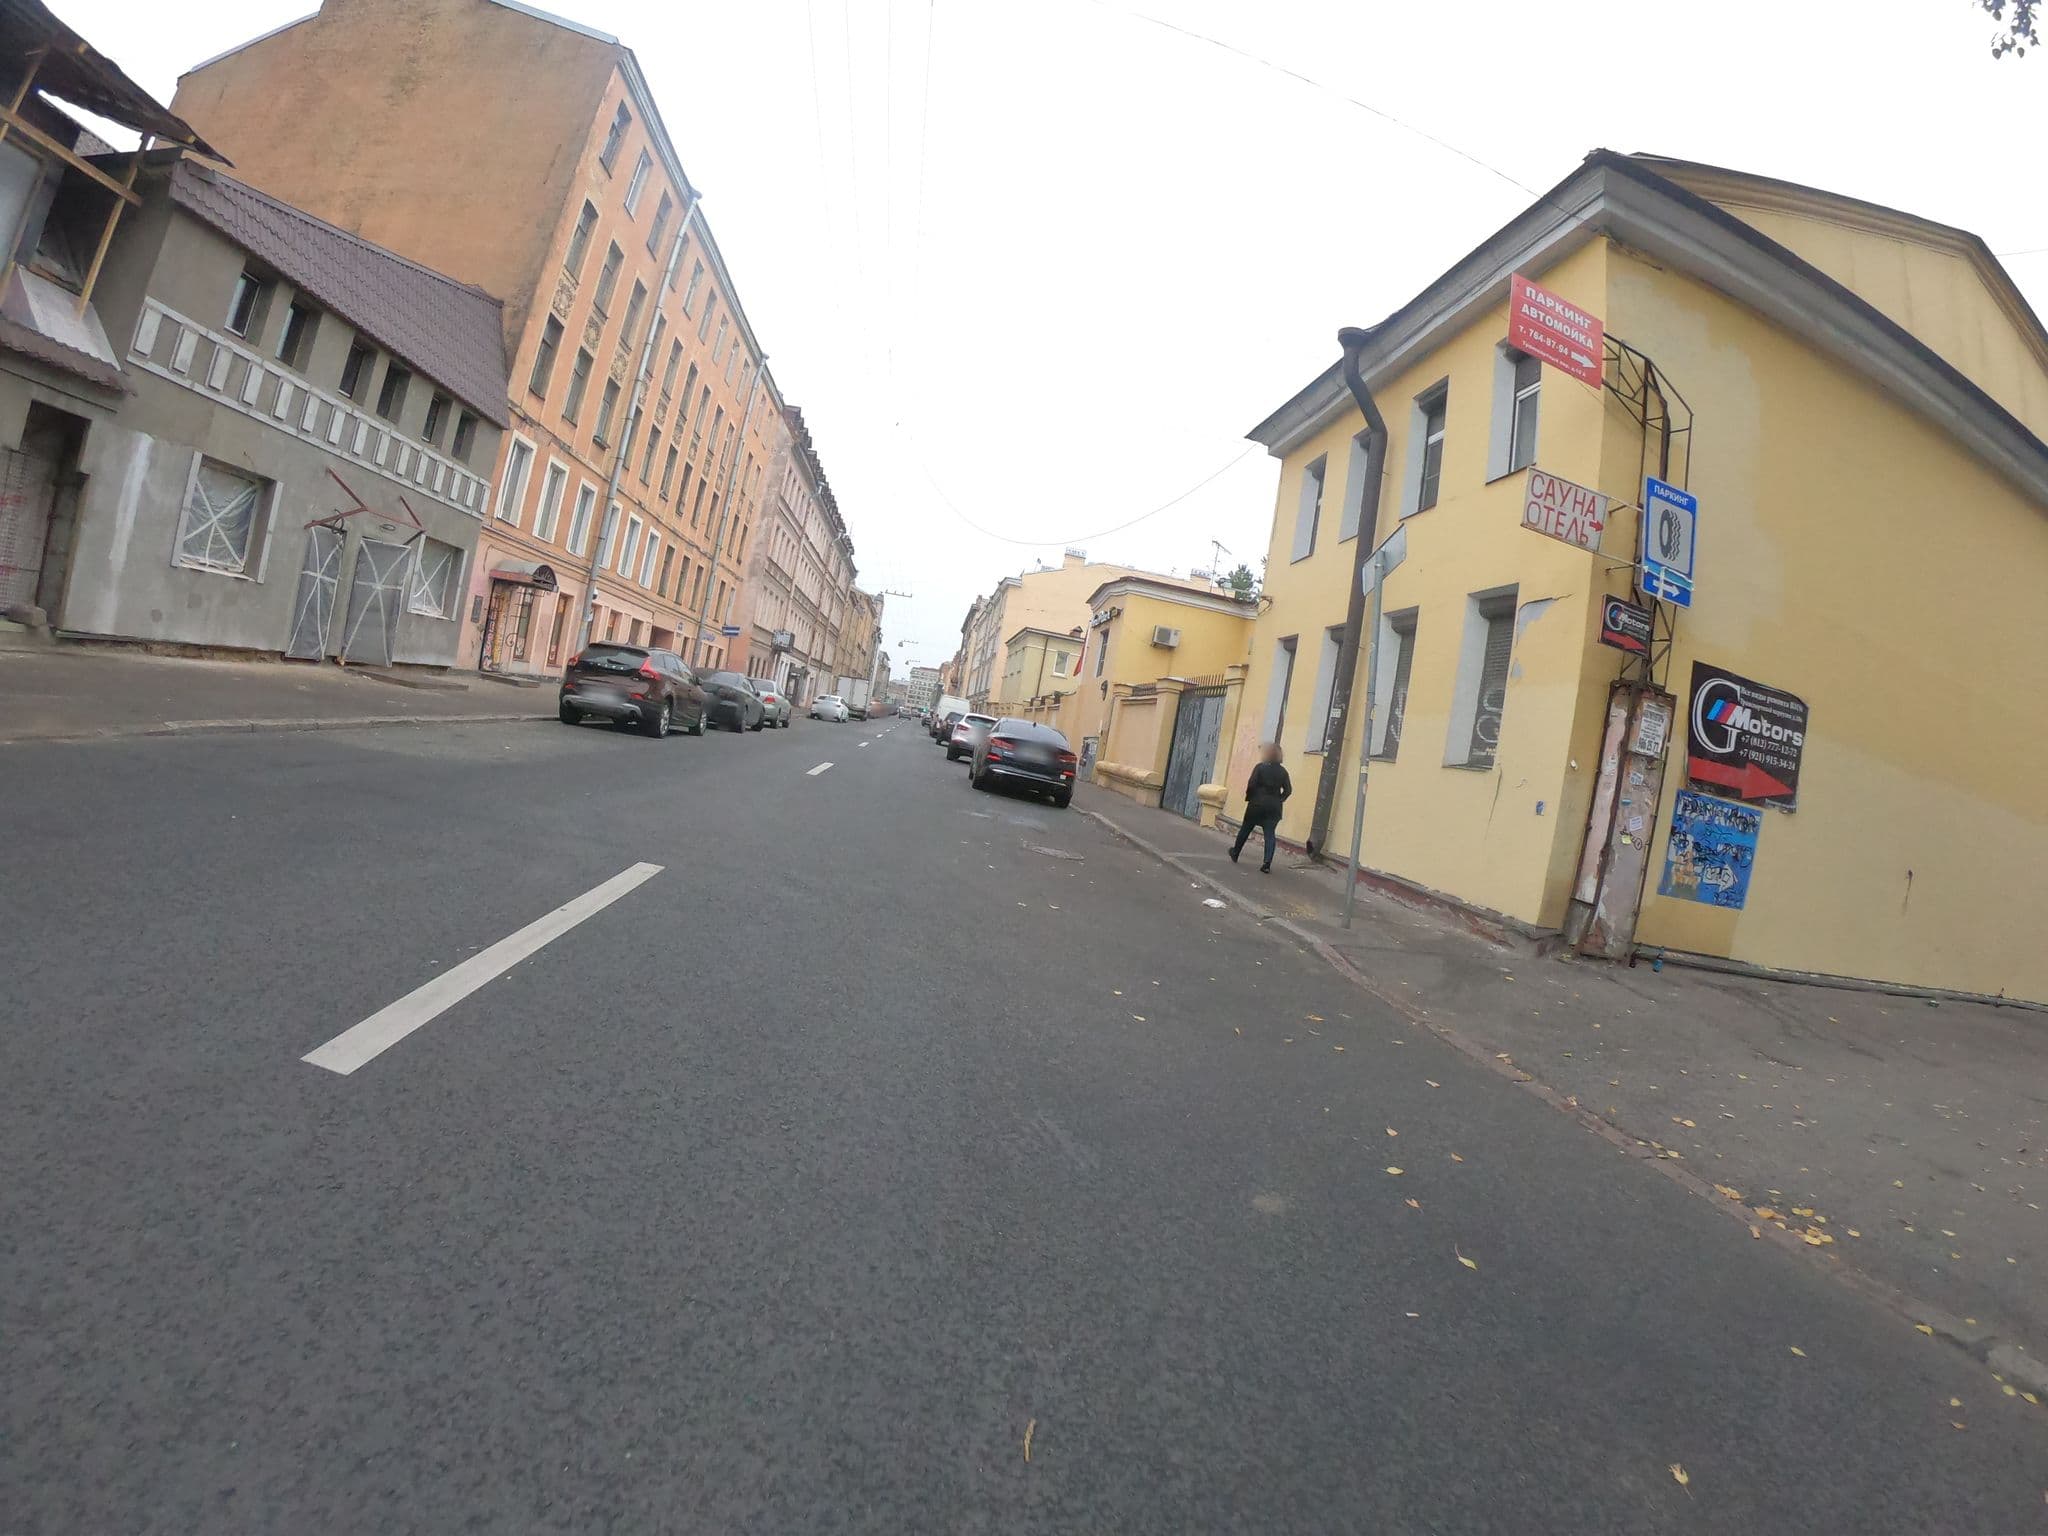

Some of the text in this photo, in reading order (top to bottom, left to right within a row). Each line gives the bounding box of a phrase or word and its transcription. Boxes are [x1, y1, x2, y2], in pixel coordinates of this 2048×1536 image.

[1521, 303, 1593, 350] АВТОМОЙКА
[1526, 287, 1591, 328] ПАРКИНГ
[1531, 474, 1596, 520] САУНА
[1654, 485, 1688, 505] ПАРКИНГ
[1527, 501, 1588, 546] ОТЕЛЬ
[1727, 705, 1803, 746] Motors
